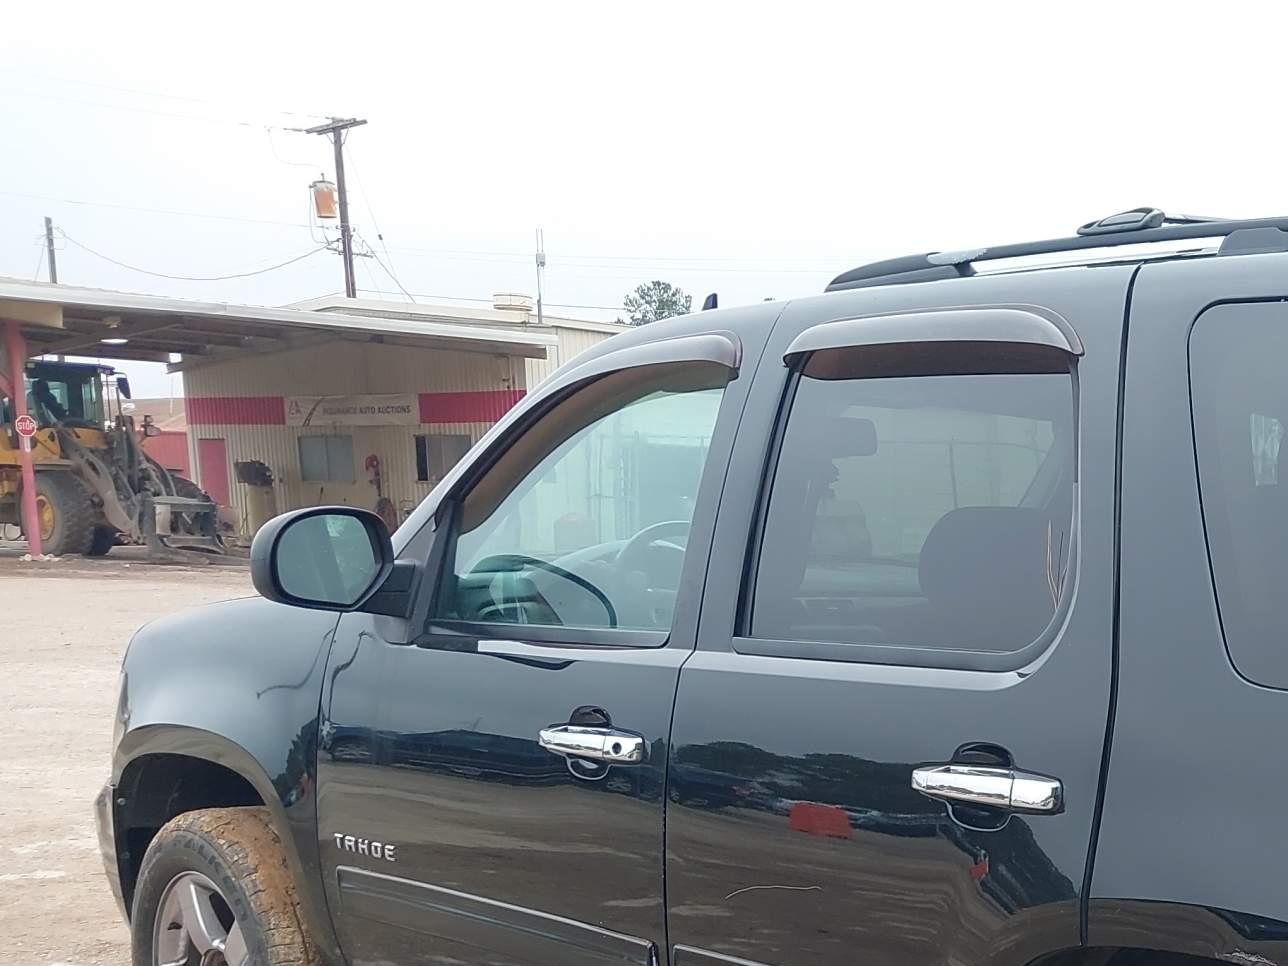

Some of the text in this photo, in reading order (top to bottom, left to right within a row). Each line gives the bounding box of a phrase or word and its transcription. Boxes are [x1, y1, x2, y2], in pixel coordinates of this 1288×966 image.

[359, 406, 376, 415] AUTO
[377, 404, 412, 415] AUCTIONS
[17, 420, 34, 431] STOP
[333, 832, 398, 862] TAHOE
